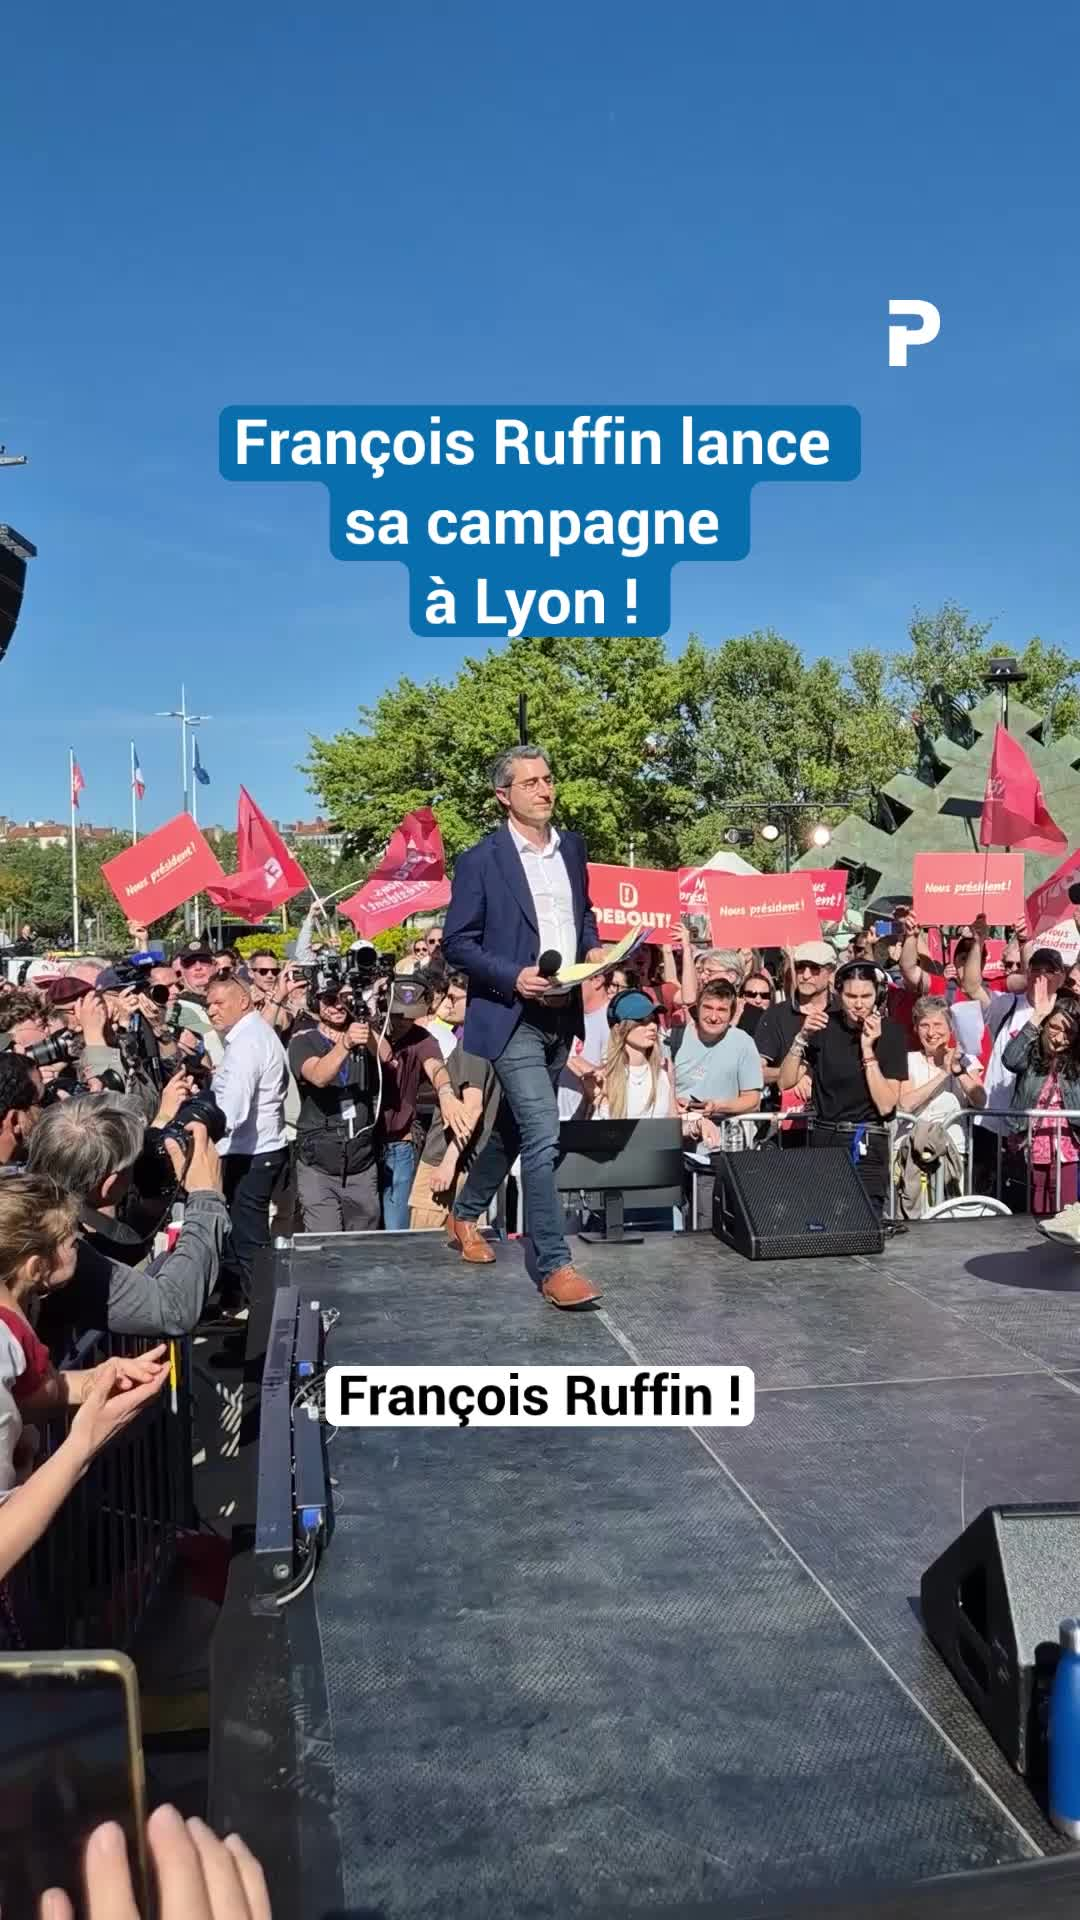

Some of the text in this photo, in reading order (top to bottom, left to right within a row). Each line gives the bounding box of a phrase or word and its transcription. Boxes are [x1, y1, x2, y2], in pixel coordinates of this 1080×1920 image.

[125, 877, 149, 895] Nous
[925, 882, 951, 894] Nous
[719, 905, 746, 917] Nous
